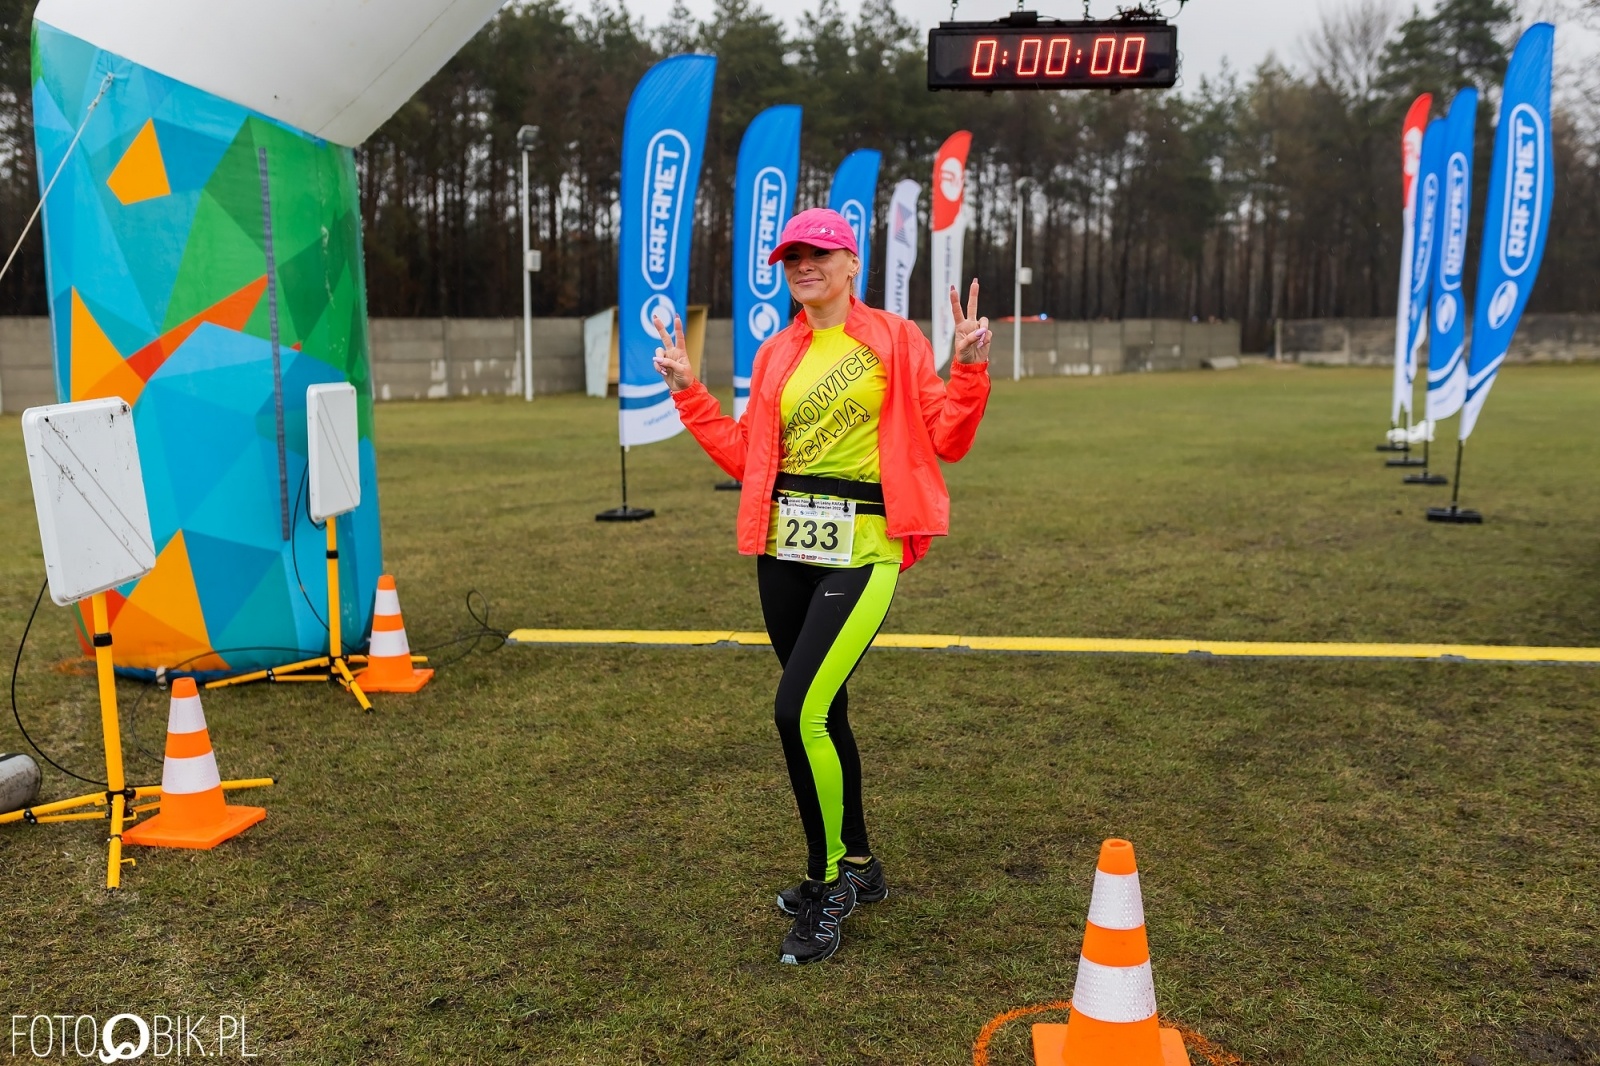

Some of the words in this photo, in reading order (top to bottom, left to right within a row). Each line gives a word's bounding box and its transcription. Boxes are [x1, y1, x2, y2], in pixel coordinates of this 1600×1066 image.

[971, 37, 1145, 77] 0:00:00
[649, 143, 680, 273] RAFAMET
[756, 177, 780, 286] RAFAMET
[1507, 117, 1535, 259] RAFAMET
[785, 518, 839, 551] 233
